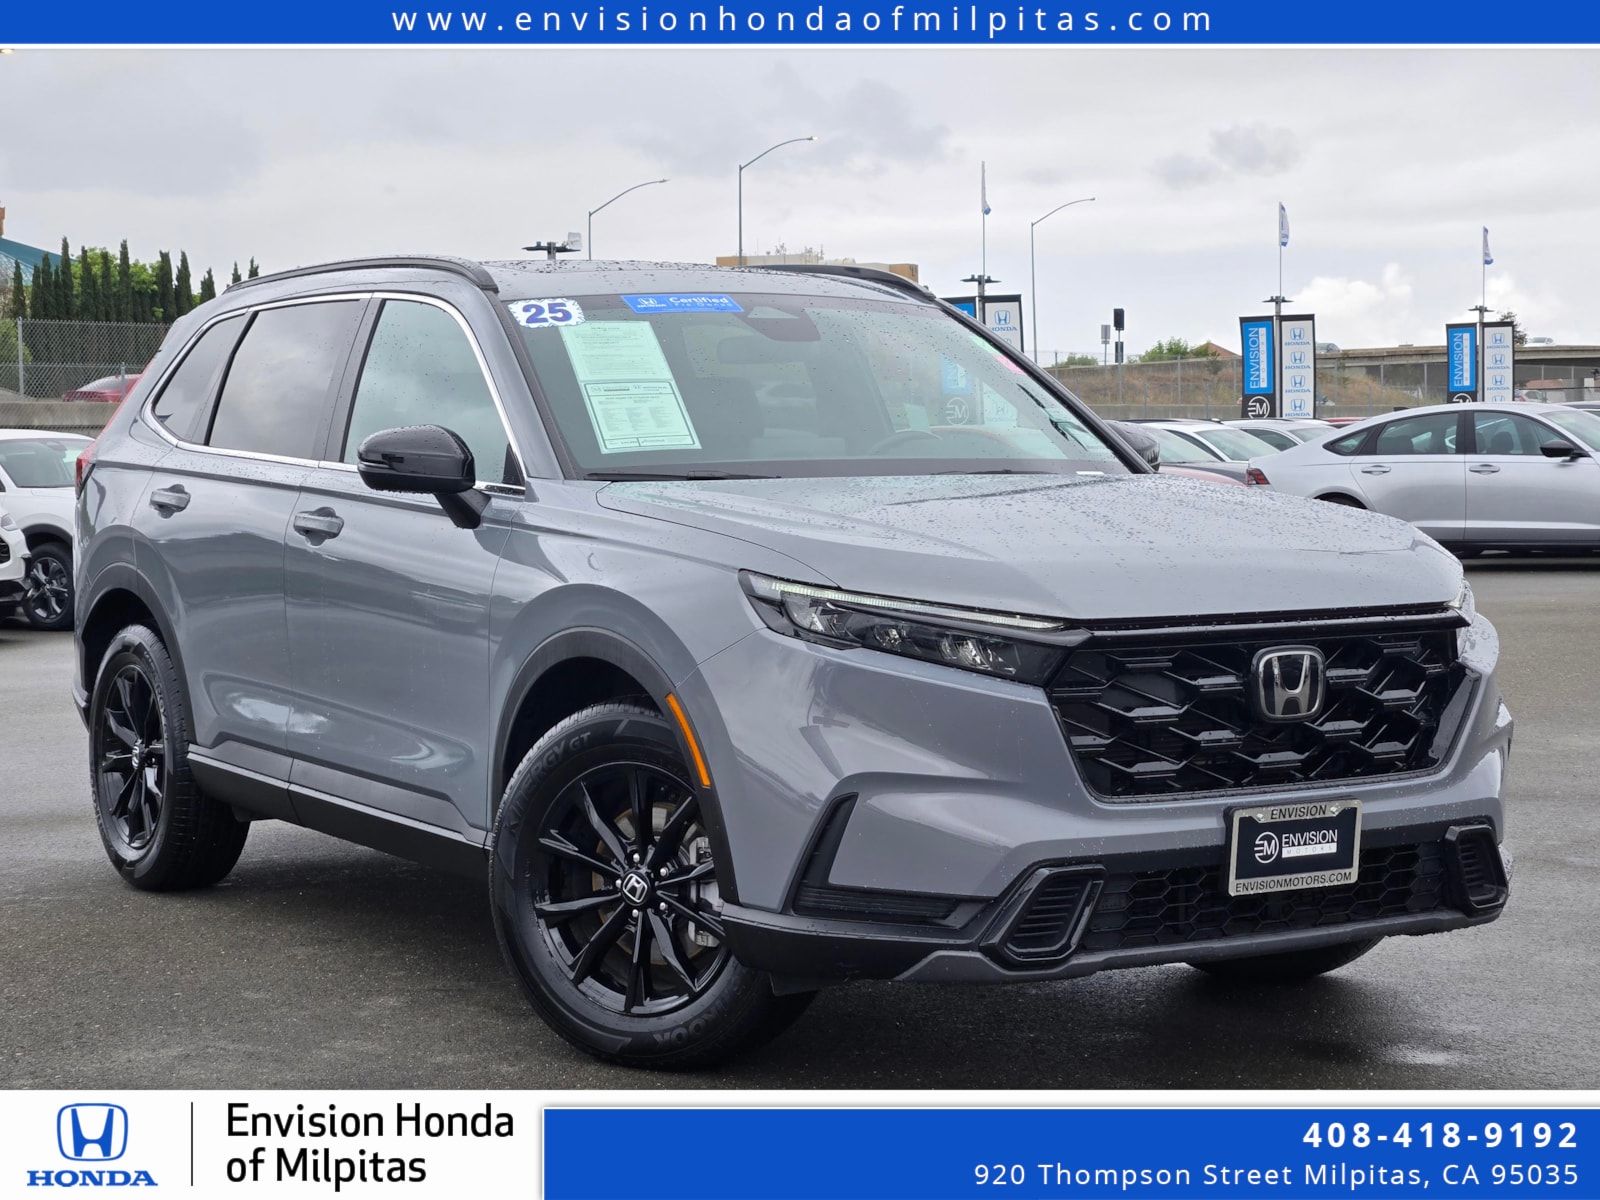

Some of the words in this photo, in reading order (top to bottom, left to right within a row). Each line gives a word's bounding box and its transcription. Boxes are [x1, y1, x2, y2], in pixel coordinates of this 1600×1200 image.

[522, 302, 573, 324] 25
[1248, 327, 1260, 389] ENVISION
[1453, 332, 1463, 387] ENVISION
[1270, 804, 1328, 820] ENVISION
[1281, 829, 1338, 847] ENVISION
[1235, 871, 1352, 893] ENVISIONMOTORS.COM
